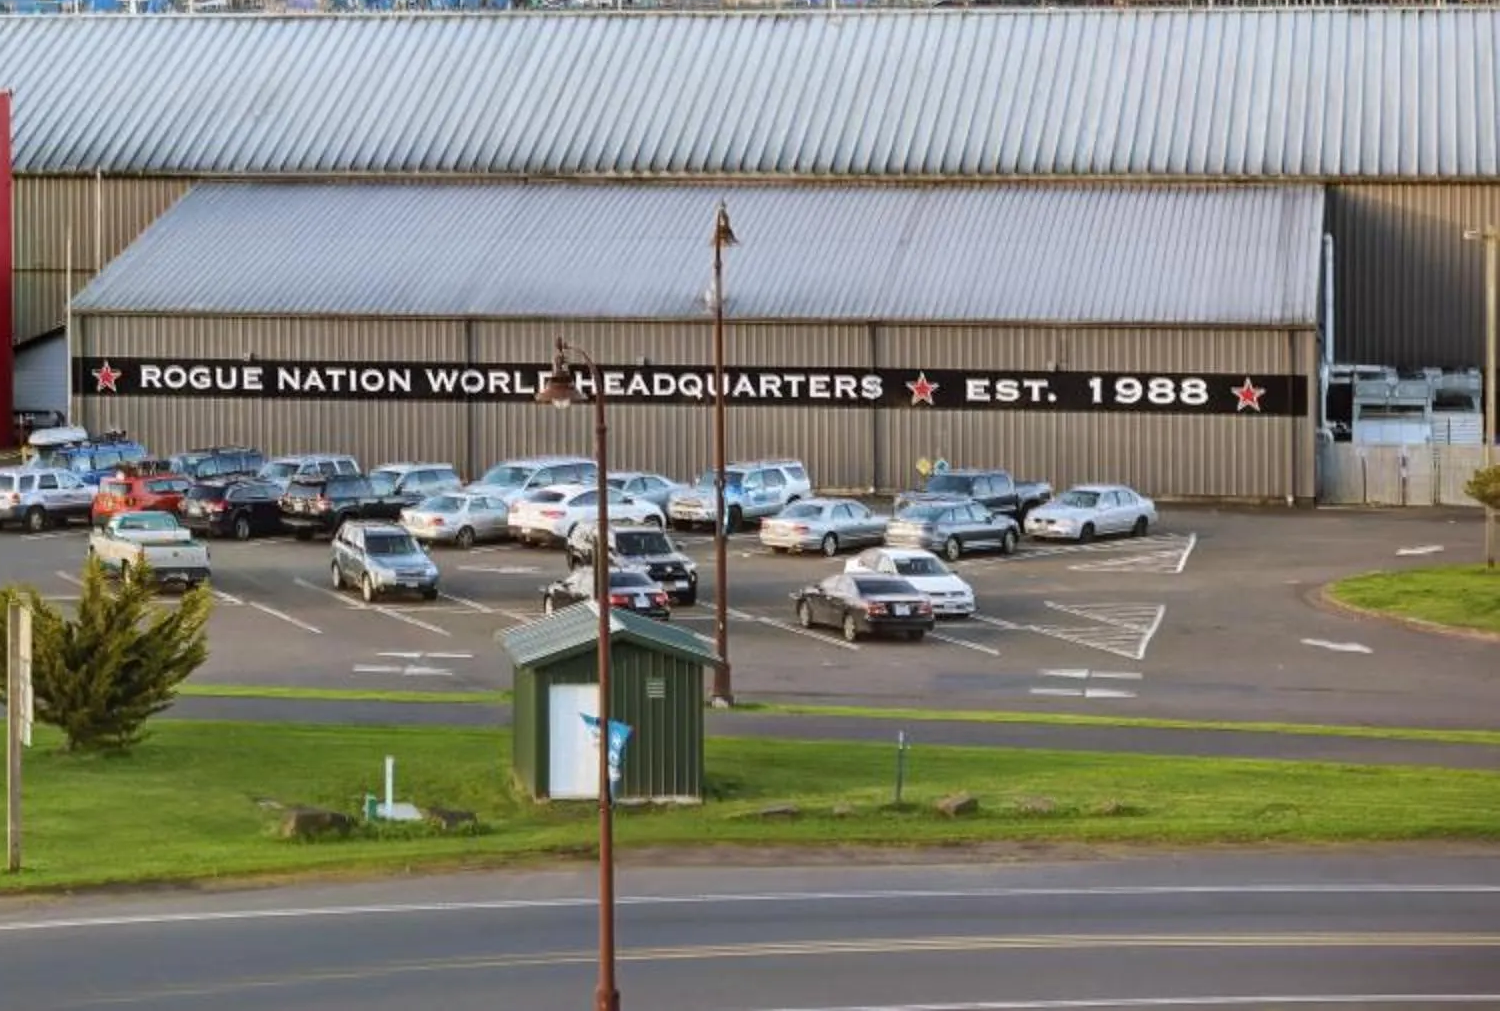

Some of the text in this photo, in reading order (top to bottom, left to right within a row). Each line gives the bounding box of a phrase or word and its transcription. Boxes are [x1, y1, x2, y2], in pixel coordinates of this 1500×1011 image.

[140, 364, 263, 390] ROGUE
[278, 367, 412, 393] NATION
[575, 371, 884, 400] HEADQUARTERS
[965, 378, 1057, 402] EST.
[1088, 377, 1209, 404] 1988
